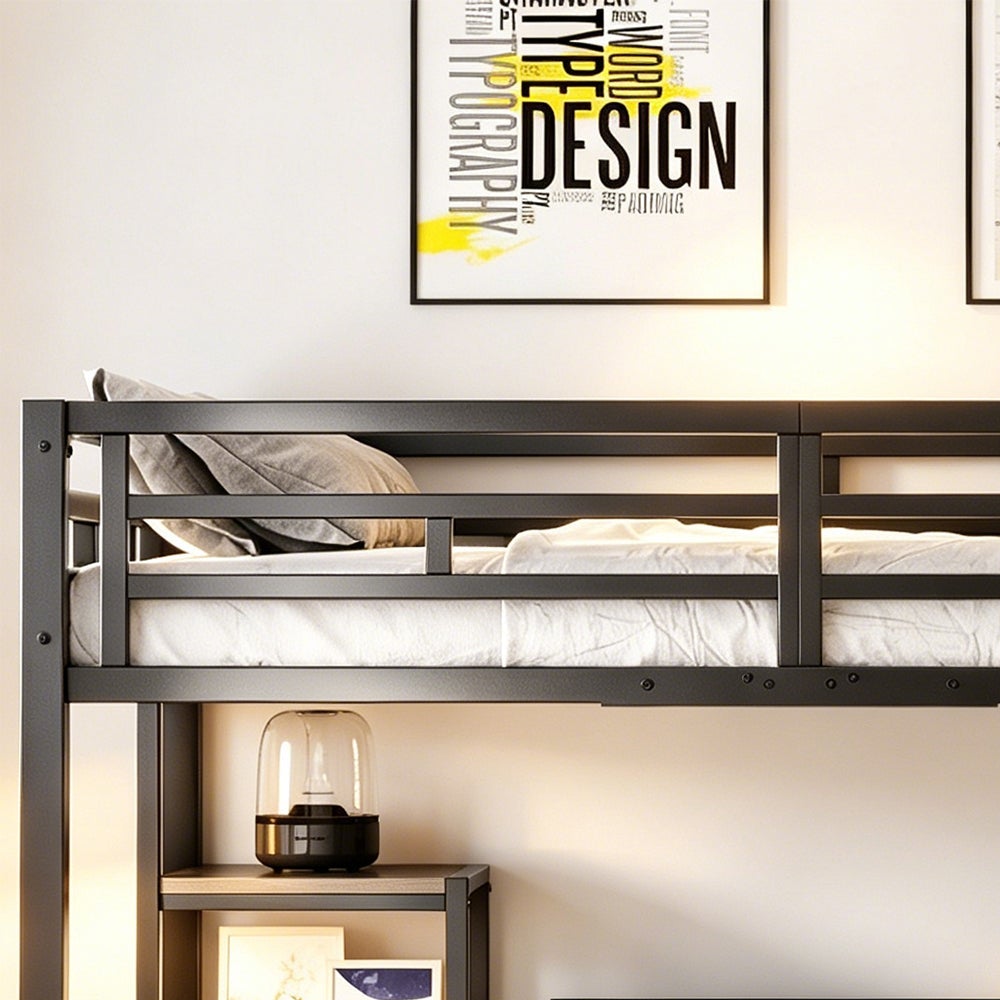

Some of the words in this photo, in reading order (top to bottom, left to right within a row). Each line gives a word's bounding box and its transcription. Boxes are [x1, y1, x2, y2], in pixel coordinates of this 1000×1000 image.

[521, 9, 605, 98] TYPE
[607, 25, 663, 99] WORD
[449, 38, 518, 235] TYPOGRAPHY
[521, 101, 737, 190] DESIGN
